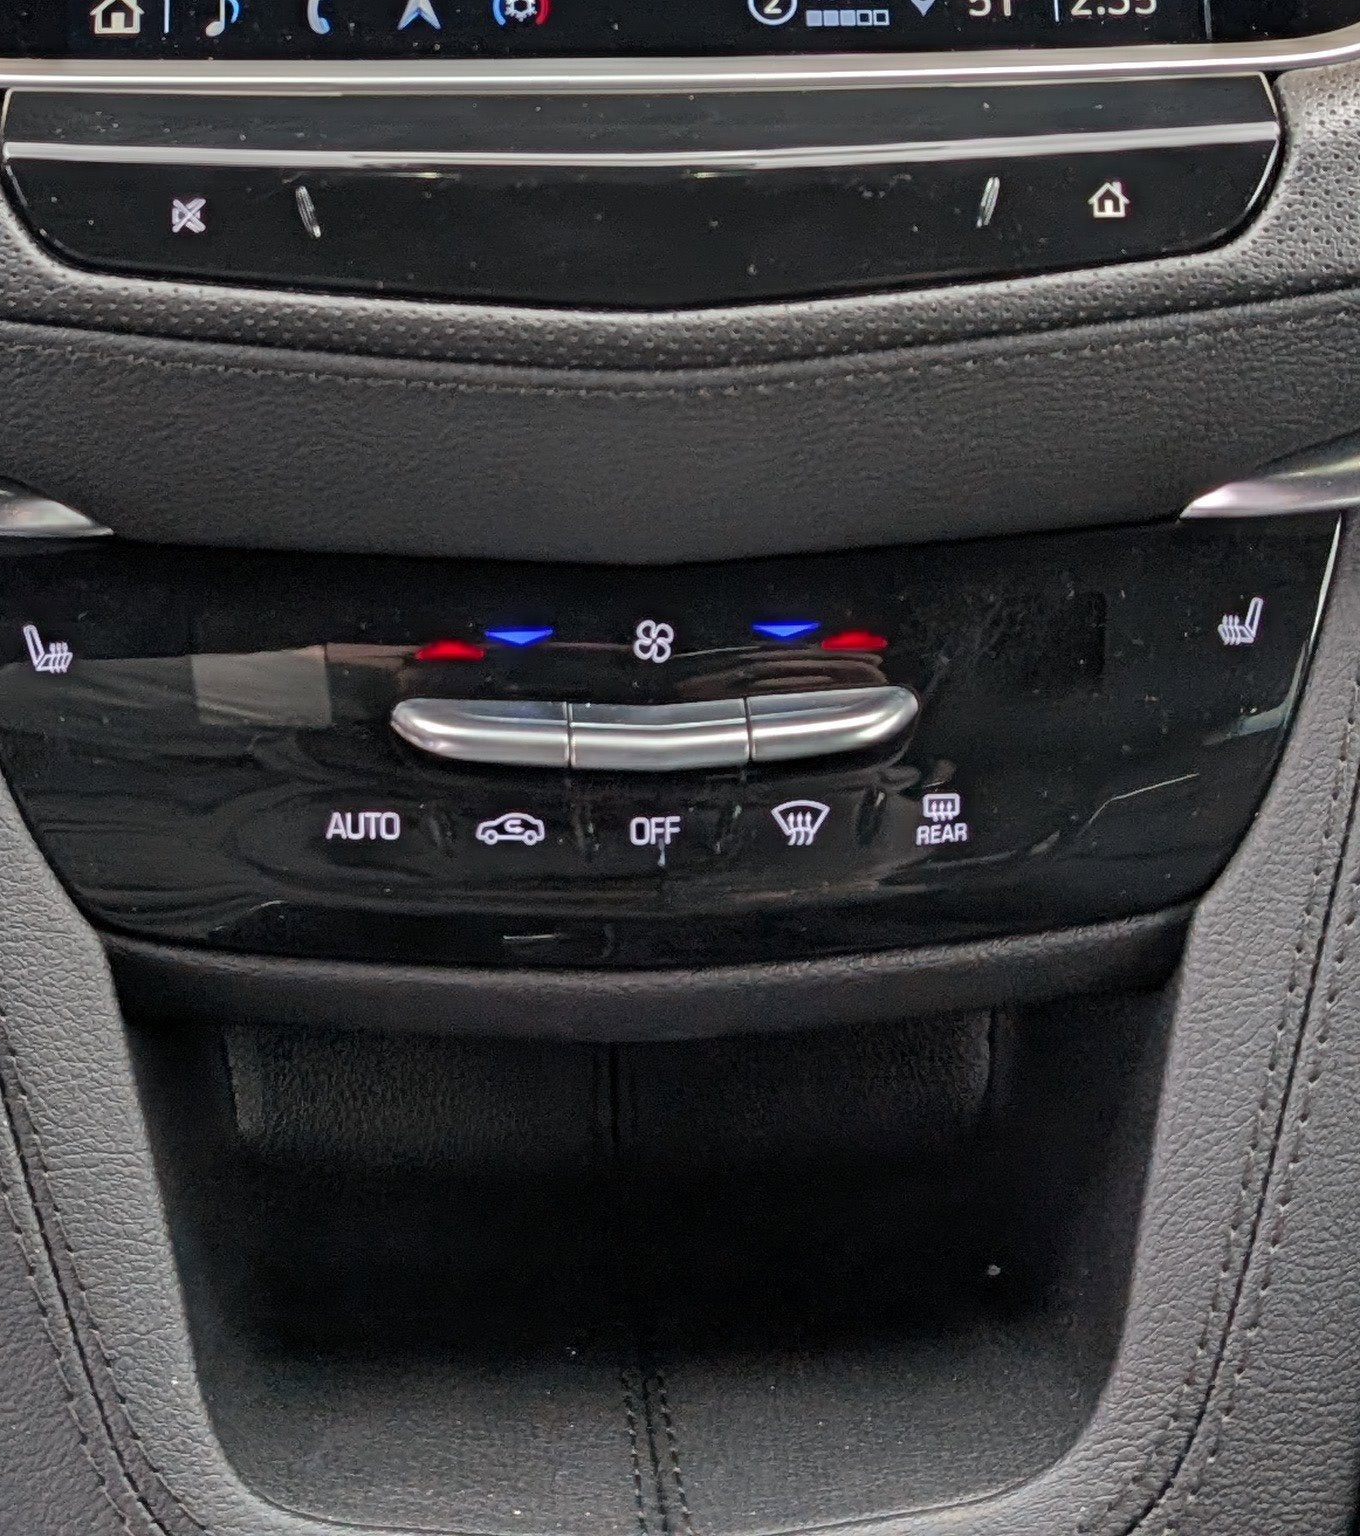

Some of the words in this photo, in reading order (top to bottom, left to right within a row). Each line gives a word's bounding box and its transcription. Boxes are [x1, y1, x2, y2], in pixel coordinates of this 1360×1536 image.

[326, 812, 401, 842] AUTO
[629, 815, 682, 847] OFF
[915, 822, 968, 845] REAR
